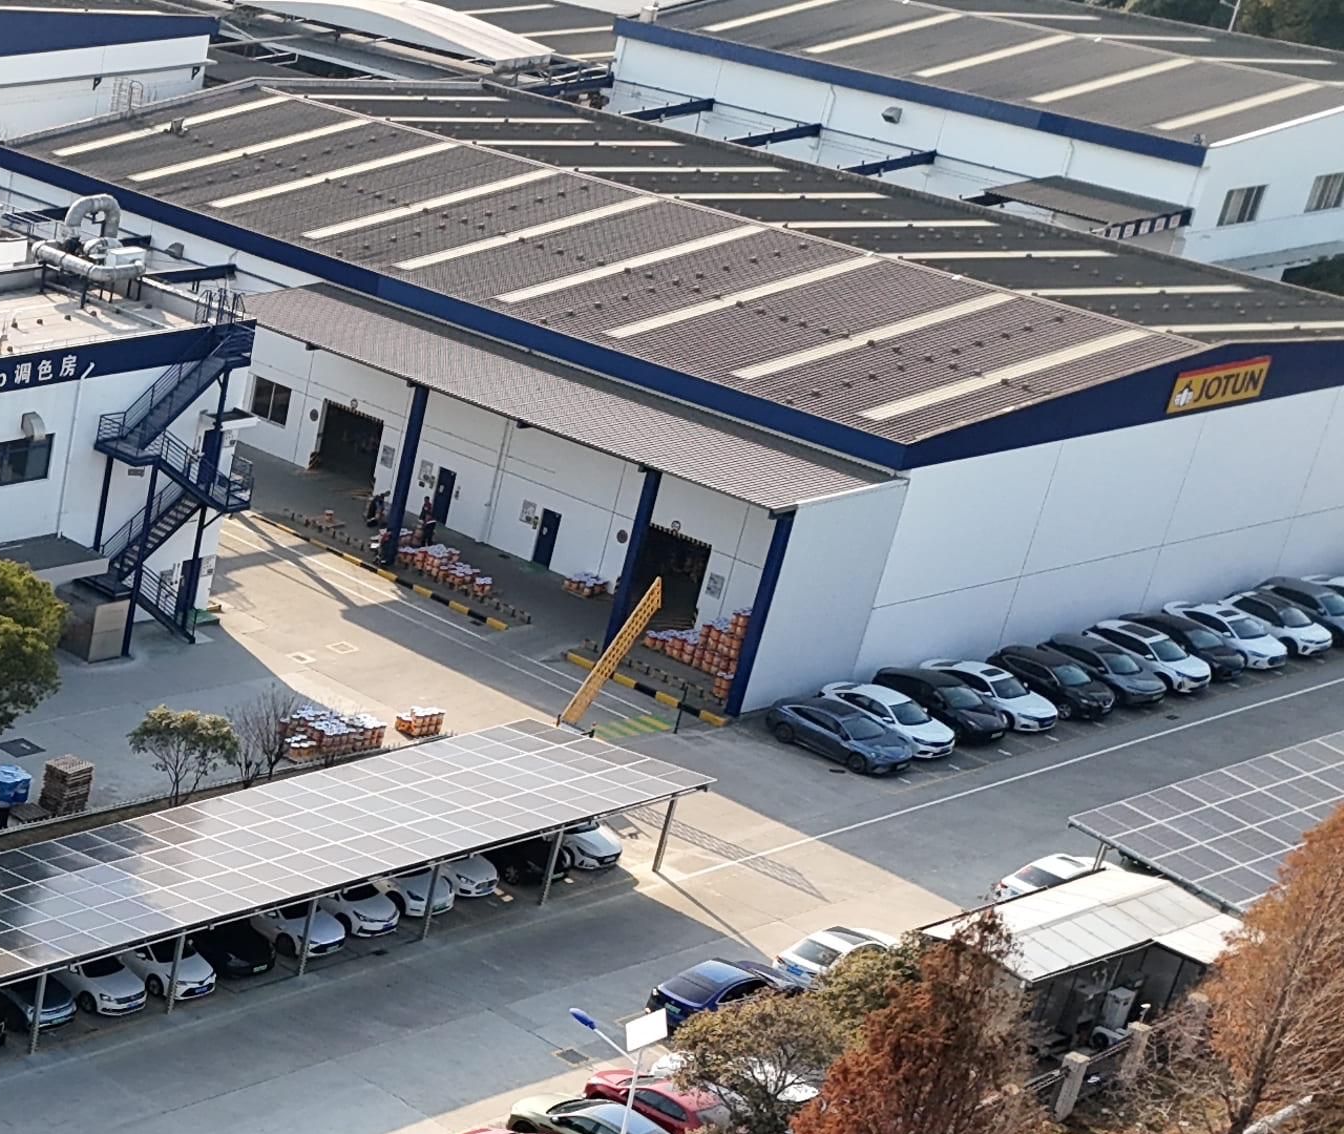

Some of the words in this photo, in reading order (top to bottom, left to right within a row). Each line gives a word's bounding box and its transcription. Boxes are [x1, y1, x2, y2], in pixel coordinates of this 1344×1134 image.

[14, 354, 78, 385] 调色房
[1193, 367, 1264, 403] JOTUN
